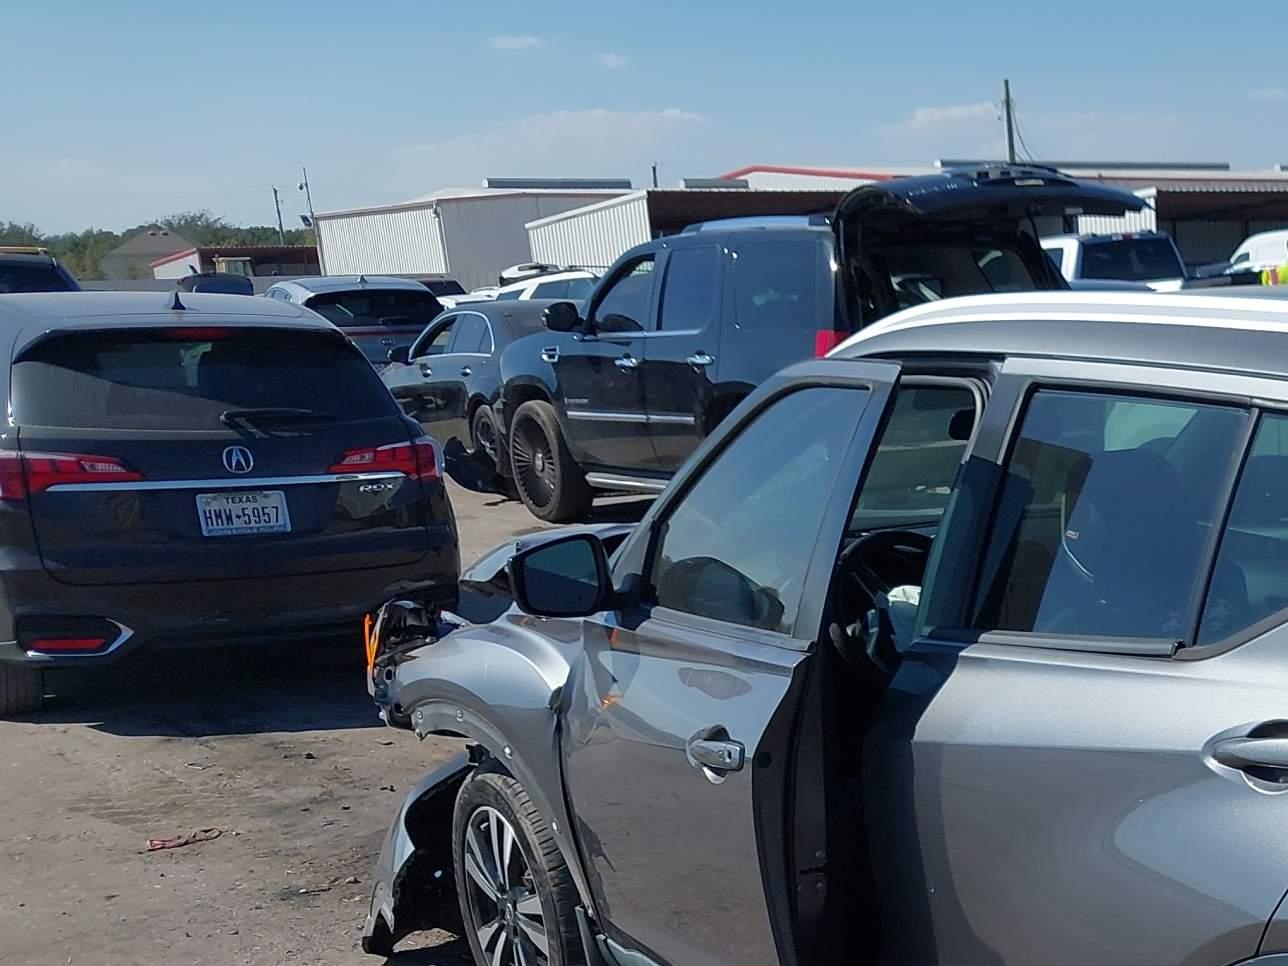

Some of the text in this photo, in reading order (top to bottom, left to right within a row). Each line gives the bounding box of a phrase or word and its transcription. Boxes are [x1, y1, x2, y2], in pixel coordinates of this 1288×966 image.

[359, 483, 394, 492] RDX
[224, 495, 258, 504] TEXAS
[240, 505, 279, 525] 5957
